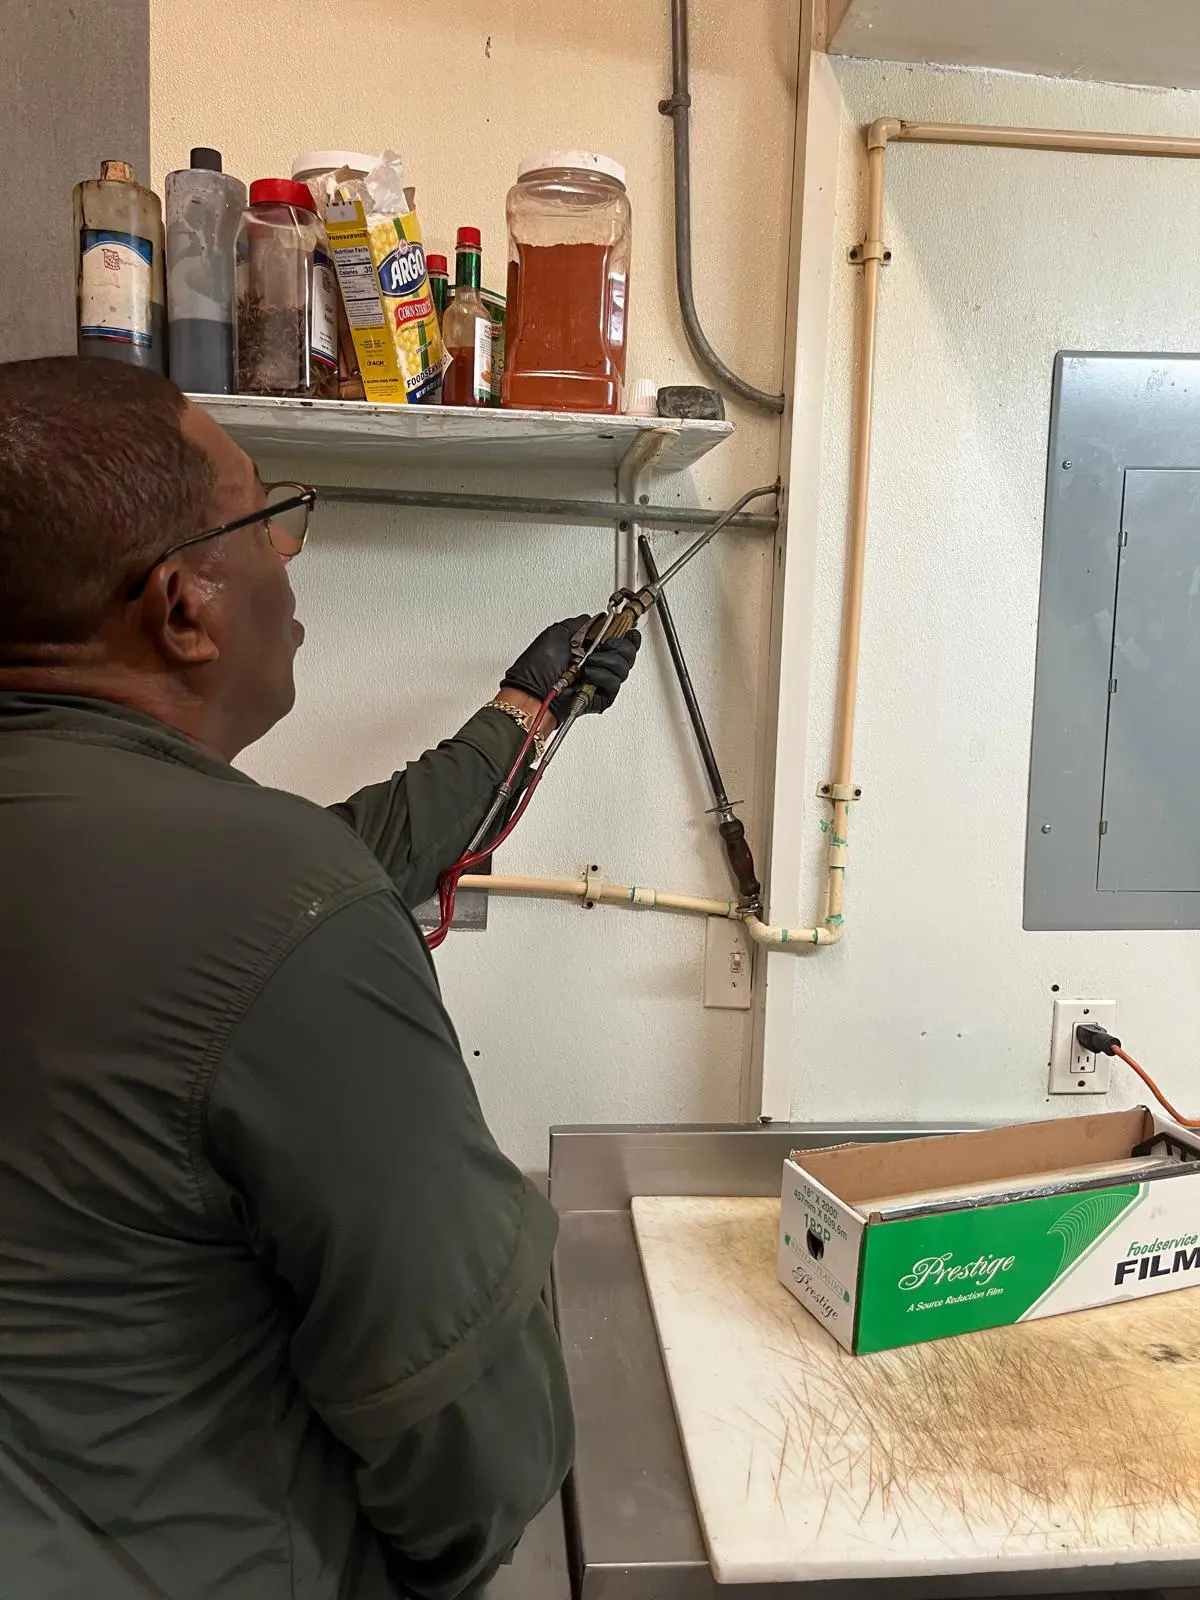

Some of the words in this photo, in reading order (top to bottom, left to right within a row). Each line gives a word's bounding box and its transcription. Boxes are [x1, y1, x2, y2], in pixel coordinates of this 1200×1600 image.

[364, 266, 373, 274] 30
[391, 249, 425, 290] ARGO
[398, 305, 415, 321] CORN
[794, 1189, 816, 1214] 457mm
[817, 1207, 822, 1219] X
[815, 1192, 821, 1204] X
[1126, 1233, 1198, 1257] Foodservice
[898, 1252, 1016, 1291] Prestige
[1114, 1246, 1200, 1286] FILM
[792, 1266, 840, 1320] Prestige
[906, 1303, 914, 1312] A
[915, 1299, 944, 1311] Source
[945, 1291, 985, 1305] Reduction
[986, 1287, 1004, 1297] Film
